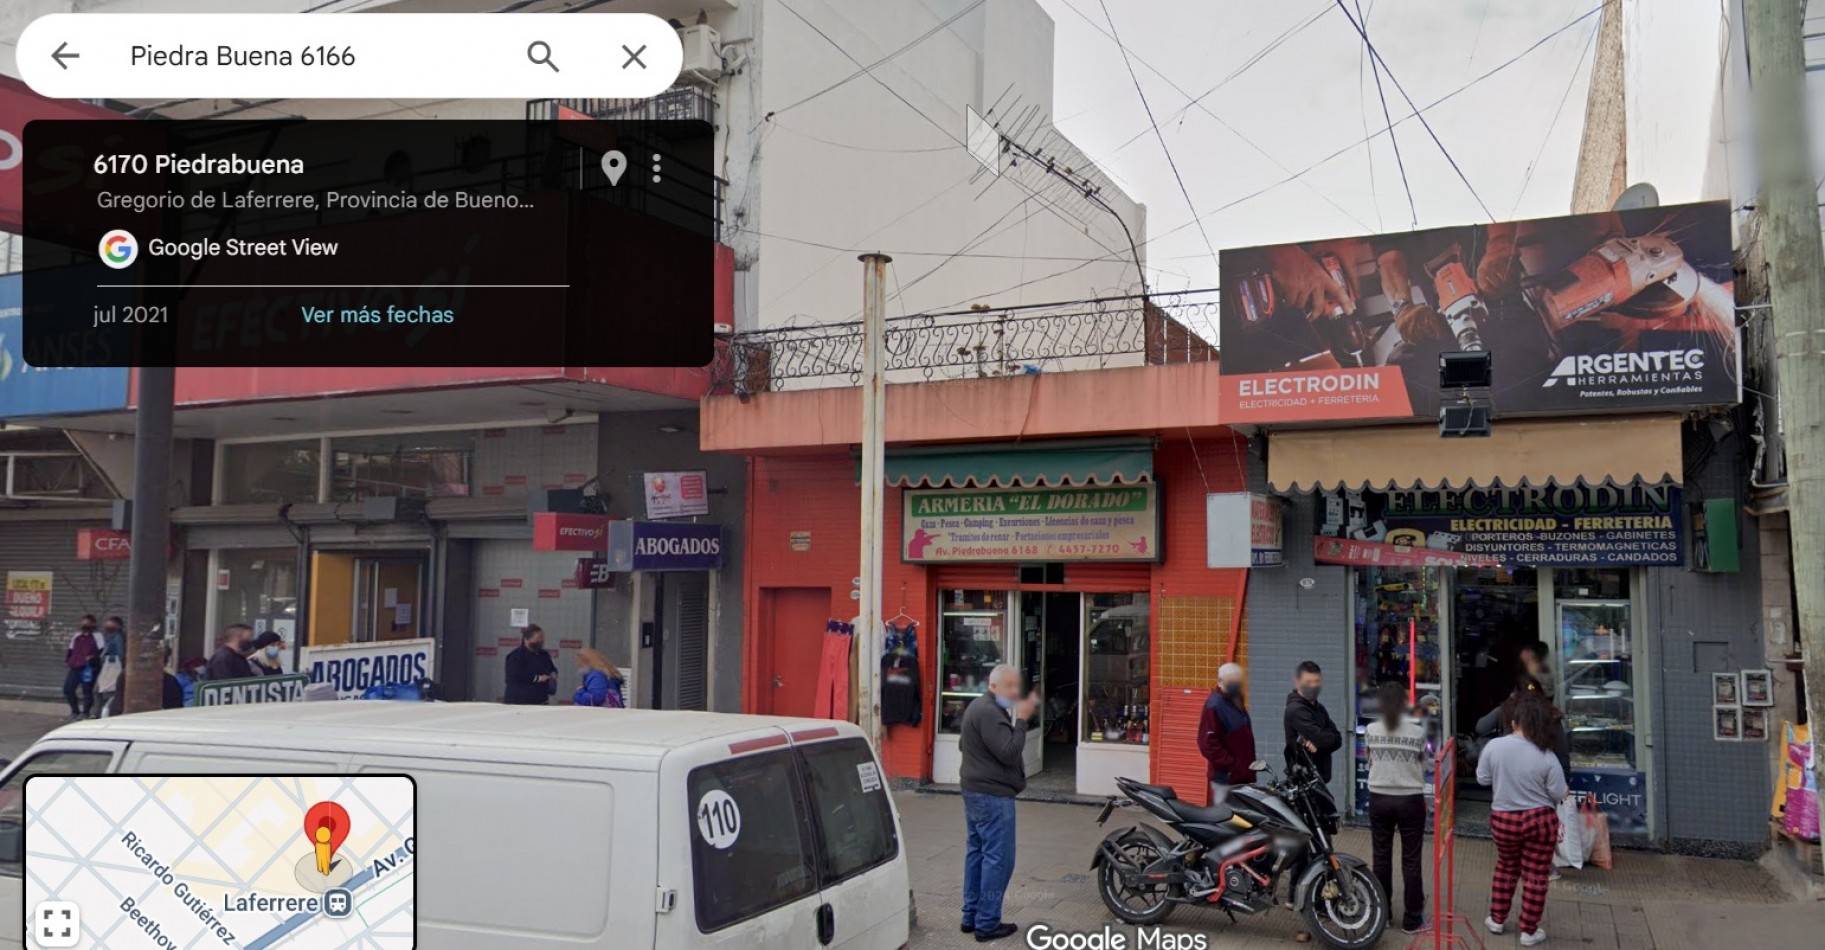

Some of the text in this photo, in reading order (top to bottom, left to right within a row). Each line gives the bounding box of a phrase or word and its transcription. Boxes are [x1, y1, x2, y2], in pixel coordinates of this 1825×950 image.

[1542, 349, 1705, 388] ARGENTEC
[1238, 372, 1380, 397] ELECTRODIN
[1578, 370, 1704, 387] HERRAMIENTAS
[1579, 385, 1703, 398] Potentes, Robustas y Confiables
[1238, 396, 1307, 410] ELECTRICIDAD
[1317, 393, 1380, 406] FERRETERIA
[918, 496, 1006, 514] ARMERIA
[1385, 486, 1673, 516] ELECTRODIN
[920, 519, 937, 529] Caza
[940, 518, 960, 529] Pesca
[963, 517, 994, 530] Camping
[999, 516, 1041, 527] Excursiones
[1045, 515, 1079, 526] Licencias
[1080, 515, 1089, 526] de
[1090, 517, 1106, 526] caza
[1113, 516, 1135, 528] pesca
[1451, 517, 1557, 532] ELECTRICIDAD
[1573, 516, 1673, 530] FERRETERIA
[559, 526, 594, 537] EFECTIVO
[981, 531, 990, 541] de
[990, 532, 1010, 541] renar
[1015, 531, 1057, 541] Portaciones
[1057, 530, 1110, 542] empresariales
[1471, 532, 1534, 542] PORTEROS
[1606, 531, 1677, 541] GABINETES
[94, 537, 131, 551] CFA
[634, 536, 721, 556] ABOGADOS
[934, 544, 1120, 557] Av. Piedrabuena 6168 4457-7270
[1465, 542, 1545, 552] DISYUNTORES
[1554, 541, 1677, 551] TERMOMAGNETICAS
[1460, 553, 1507, 563] NIVELES
[1515, 552, 1597, 562] CERRADURAS
[1607, 551, 1678, 562] CANDADOS
[312, 651, 427, 692] ABOGADOS
[203, 679, 305, 706] DENTISTA
[701, 798, 738, 839] 110
